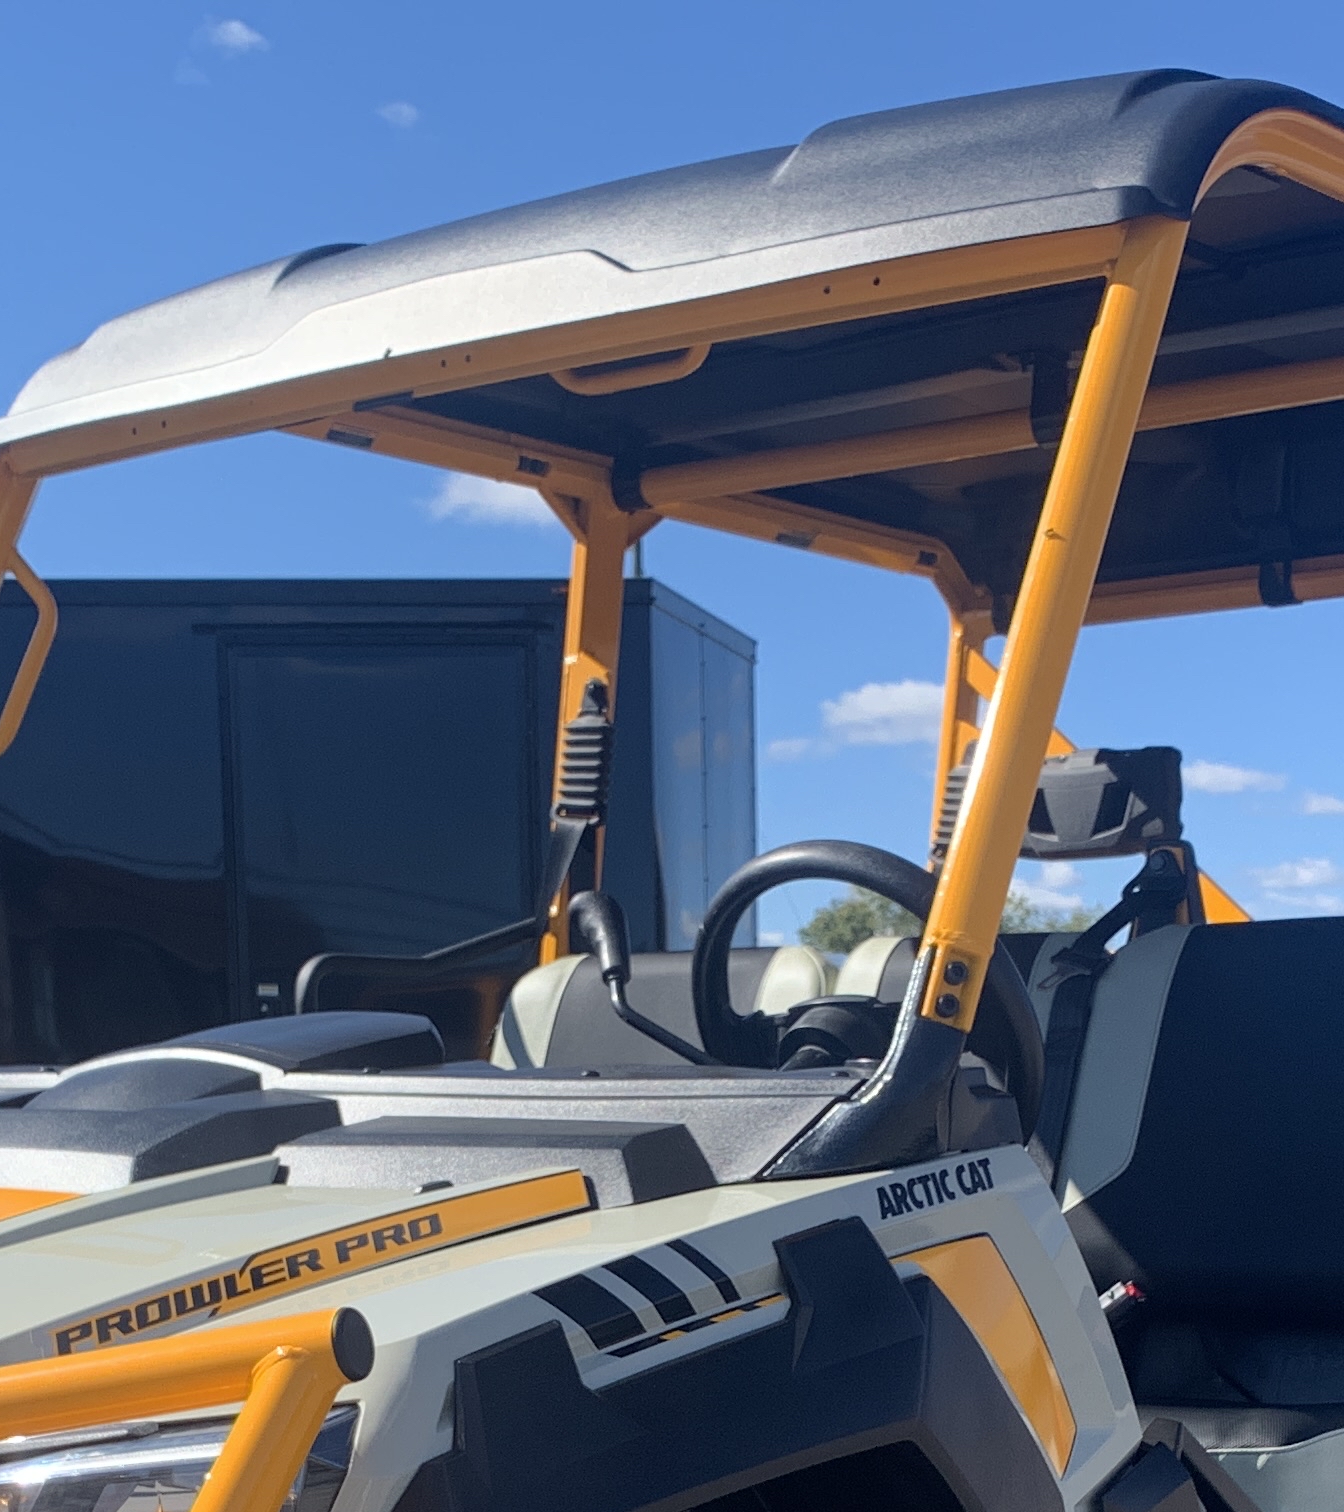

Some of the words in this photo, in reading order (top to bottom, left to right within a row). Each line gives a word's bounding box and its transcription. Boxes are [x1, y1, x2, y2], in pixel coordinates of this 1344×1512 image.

[876, 1168, 956, 1220] ARCTIC
[955, 1157, 994, 1196] CAT
[55, 1248, 324, 1355] PROWLER
[335, 1213, 443, 1264] PRO
